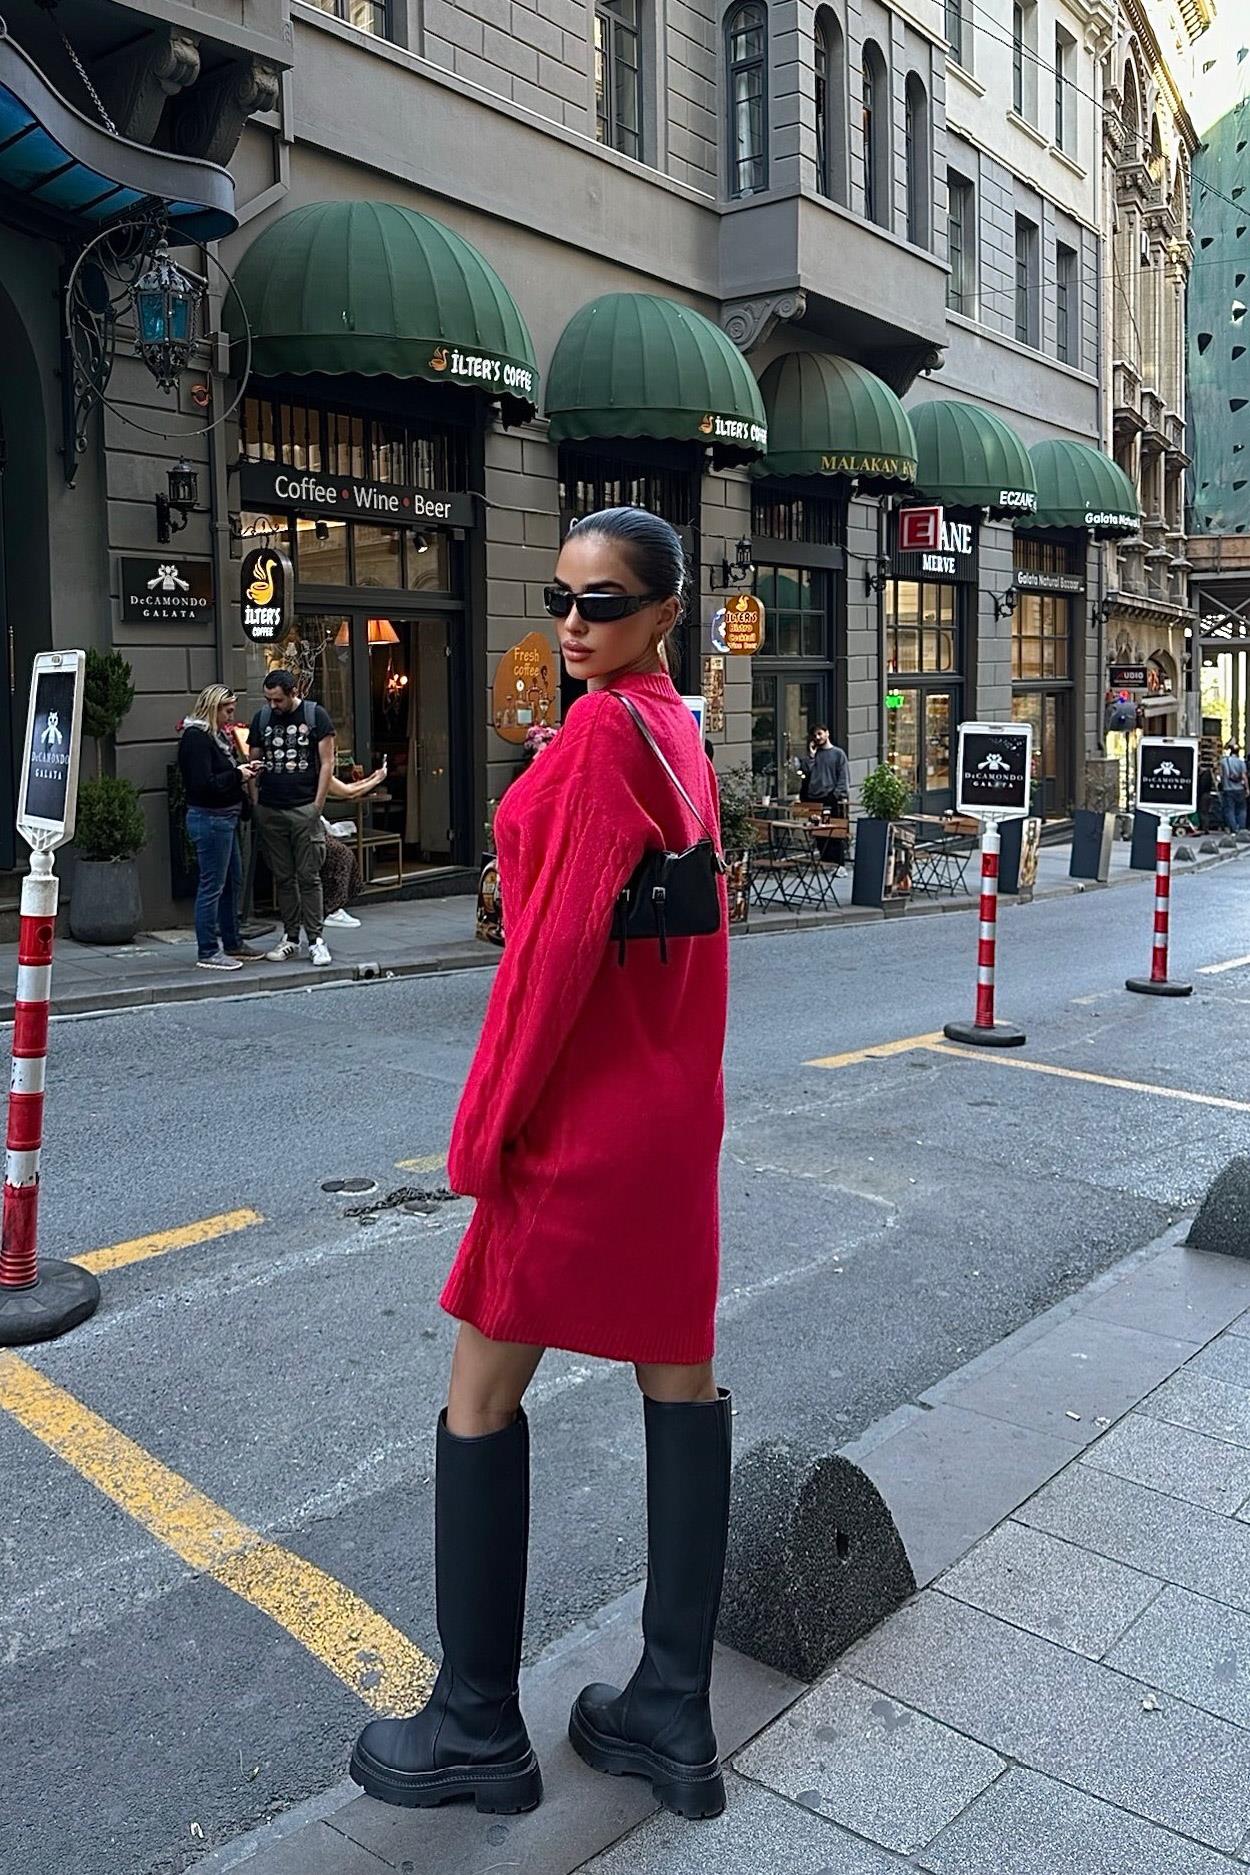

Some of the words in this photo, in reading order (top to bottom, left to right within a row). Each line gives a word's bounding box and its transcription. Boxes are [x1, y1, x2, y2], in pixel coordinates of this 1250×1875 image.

[450, 349, 501, 381] İLTER'S
[714, 415, 749, 440] İLTER'S
[820, 456, 898, 473] MALAKAN
[275, 475, 337, 503] Coffee
[353, 485, 399, 511] Wine
[414, 494, 452, 518] Beer
[1084, 512, 1118, 525] Galata
[922, 553, 956, 574] MERVE
[1017, 571, 1038, 586] Galata
[1039, 574, 1060, 588] Natural
[130, 595, 207, 607] DeCAMONDO
[143, 609, 196, 618] GALATA
[244, 605, 281, 625] İLTER'S
[252, 626, 274, 637] COFFEE
[514, 647, 540, 662] Fresh
[513, 662, 540, 676] coffee
[35, 768, 62, 780] GALATA
[964, 772, 1024, 781] DeCAMONDO
[972, 780, 1014, 788] GALATA
